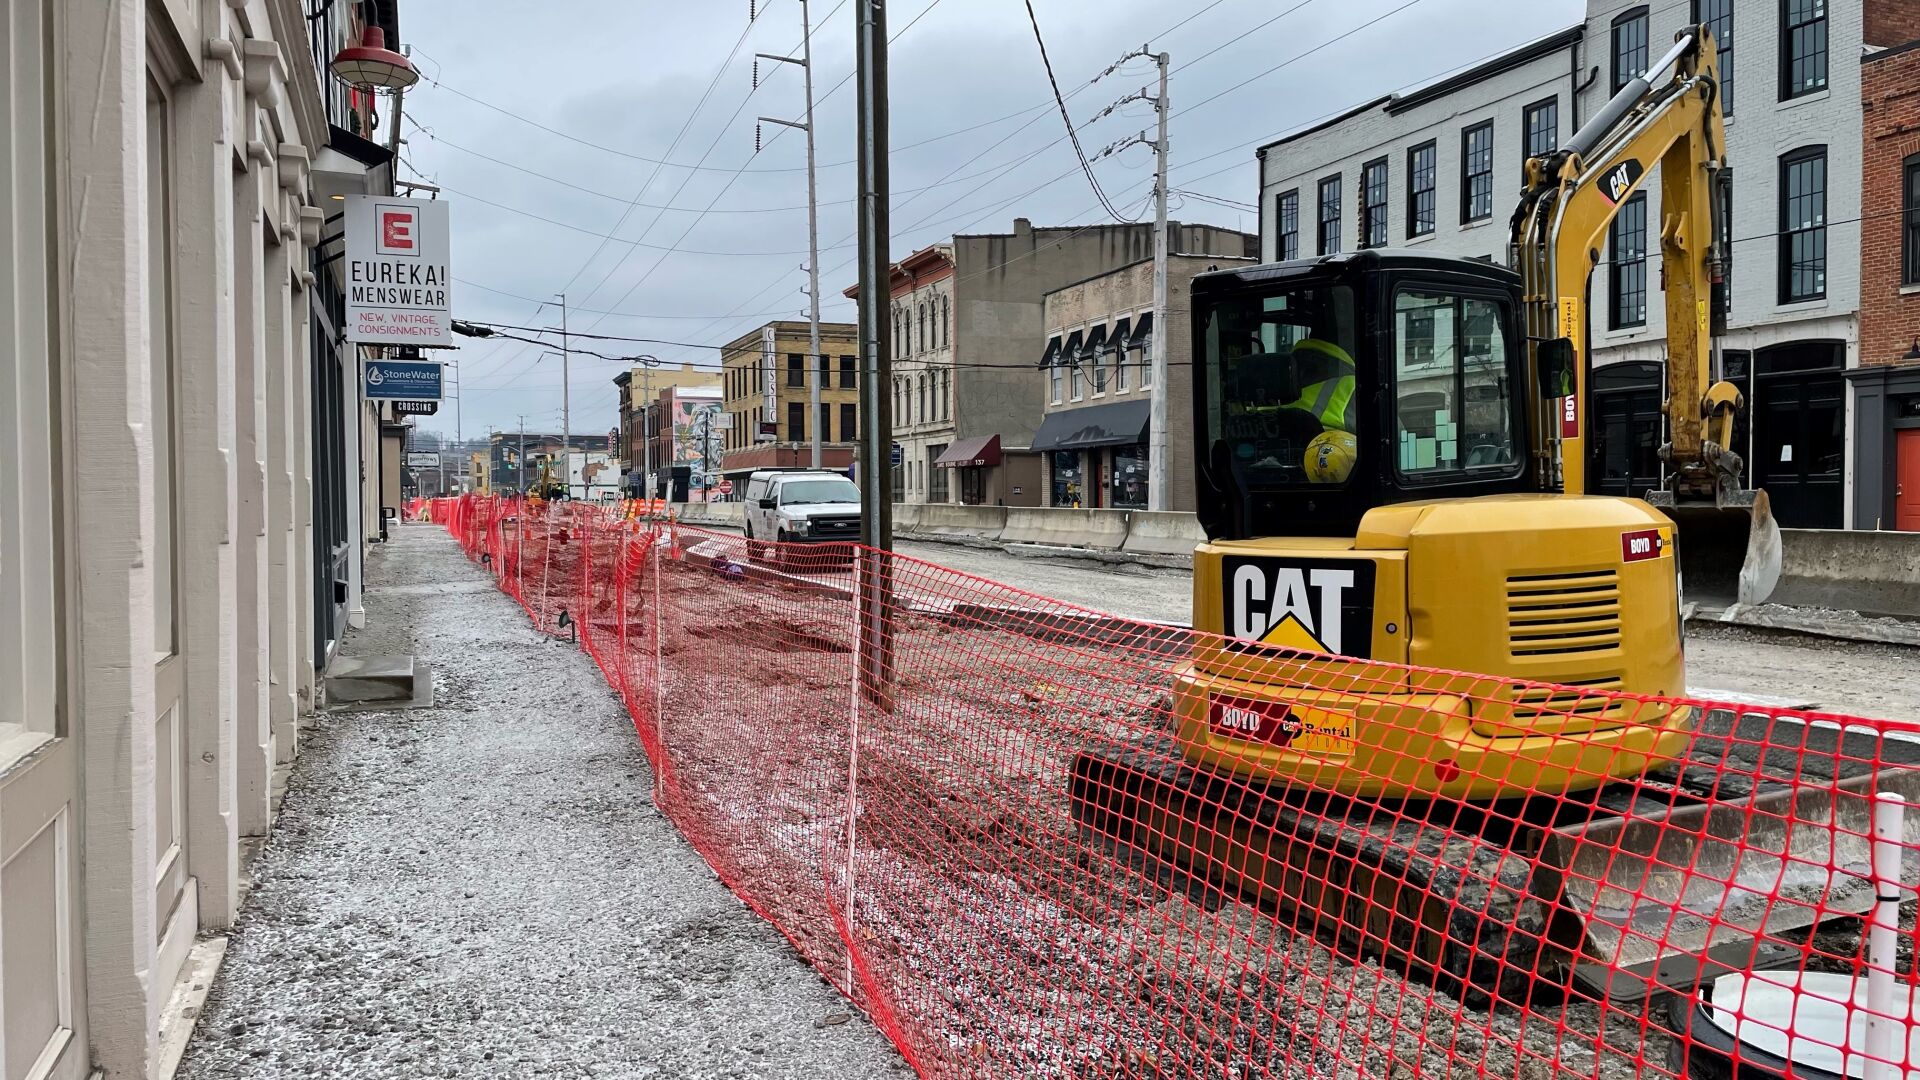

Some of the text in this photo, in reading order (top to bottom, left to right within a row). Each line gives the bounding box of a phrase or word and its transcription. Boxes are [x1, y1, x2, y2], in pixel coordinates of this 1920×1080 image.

[1610, 163, 1630, 200] CAT
[383, 212, 413, 249] E
[351, 261, 445, 287] EUREKA!
[352, 286, 445, 306] MENSWEAR
[359, 313, 439, 326] NEW, VINTAGE,
[358, 324, 441, 337] CONSIGNMENTS
[383, 369, 440, 380] StoneWater
[398, 401, 432, 412] CROSSING
[1630, 537, 1650, 554] BOYD
[1233, 564, 1354, 655] CAT
[1222, 705, 1260, 731] BOYD
[1305, 723, 1351, 738] Rental
